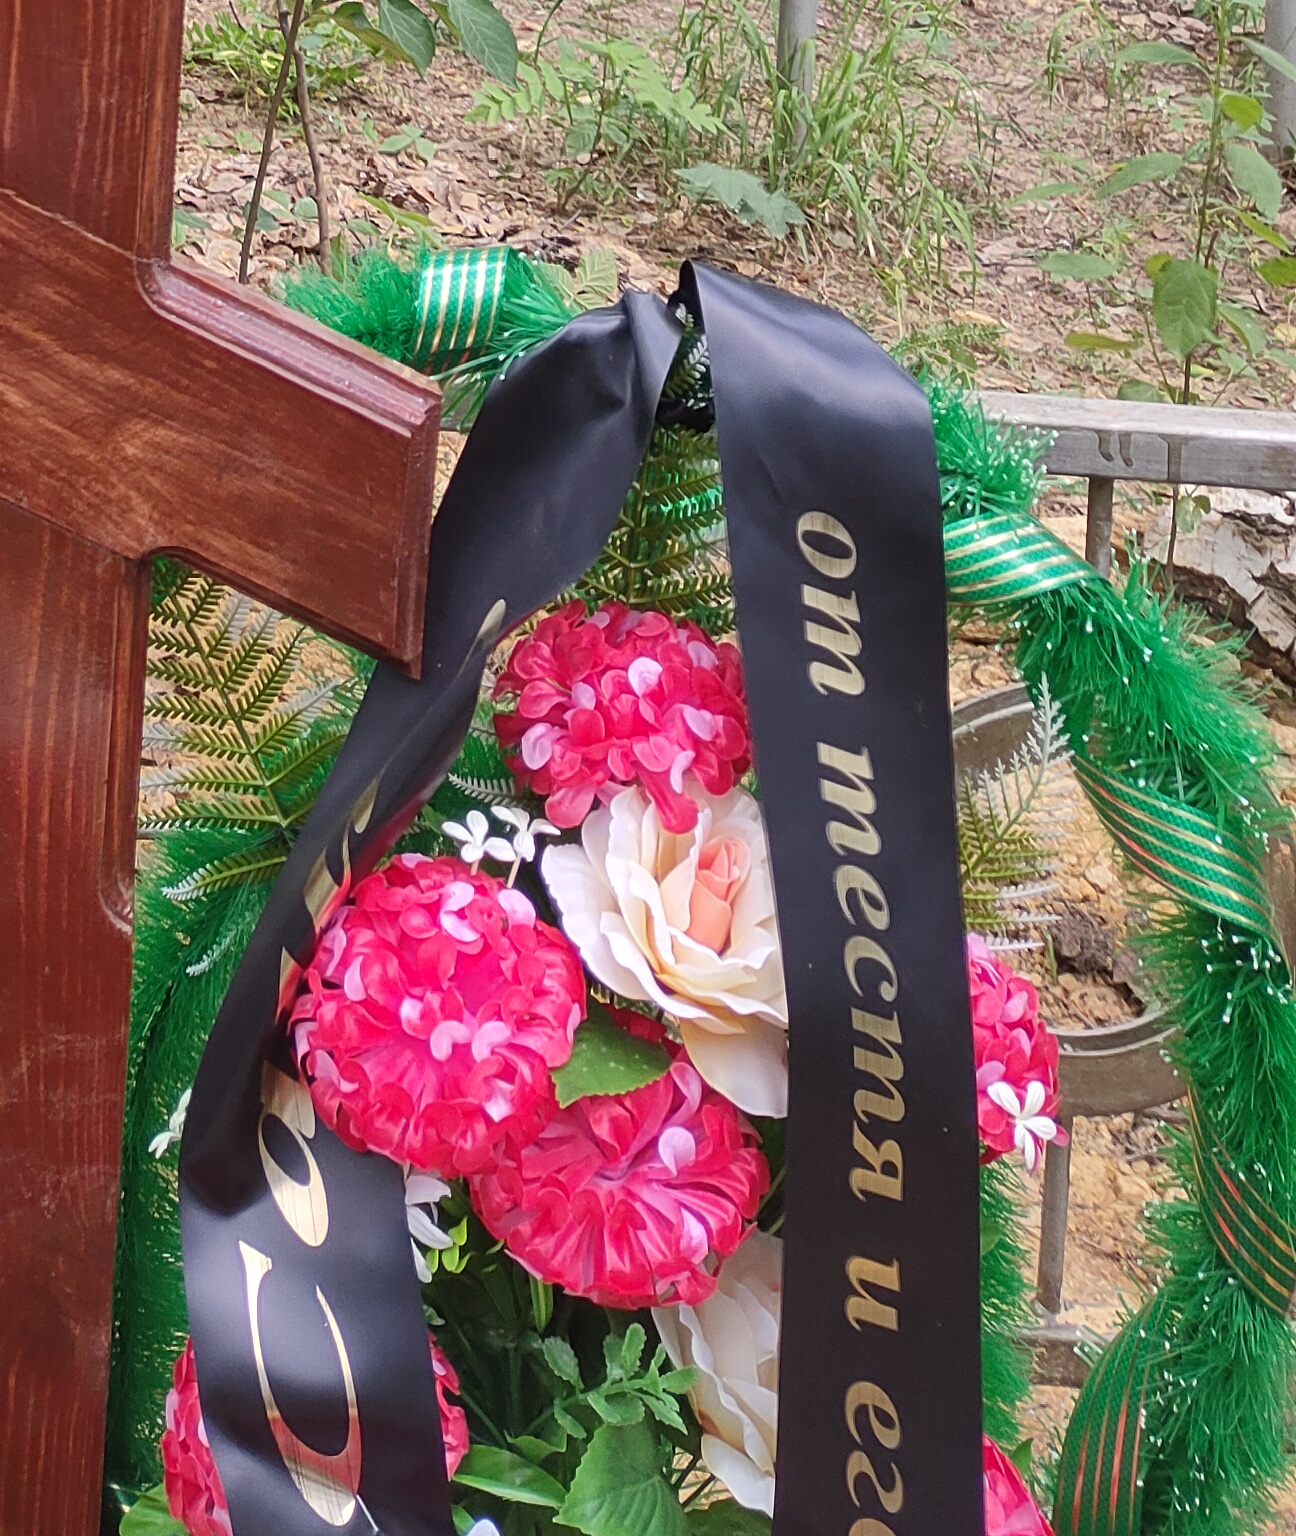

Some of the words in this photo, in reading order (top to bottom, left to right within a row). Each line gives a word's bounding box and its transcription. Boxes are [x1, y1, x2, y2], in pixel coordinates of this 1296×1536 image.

[796, 510, 867, 696] от
[816, 741, 907, 1203] тестя
[844, 1255, 902, 1332] и
